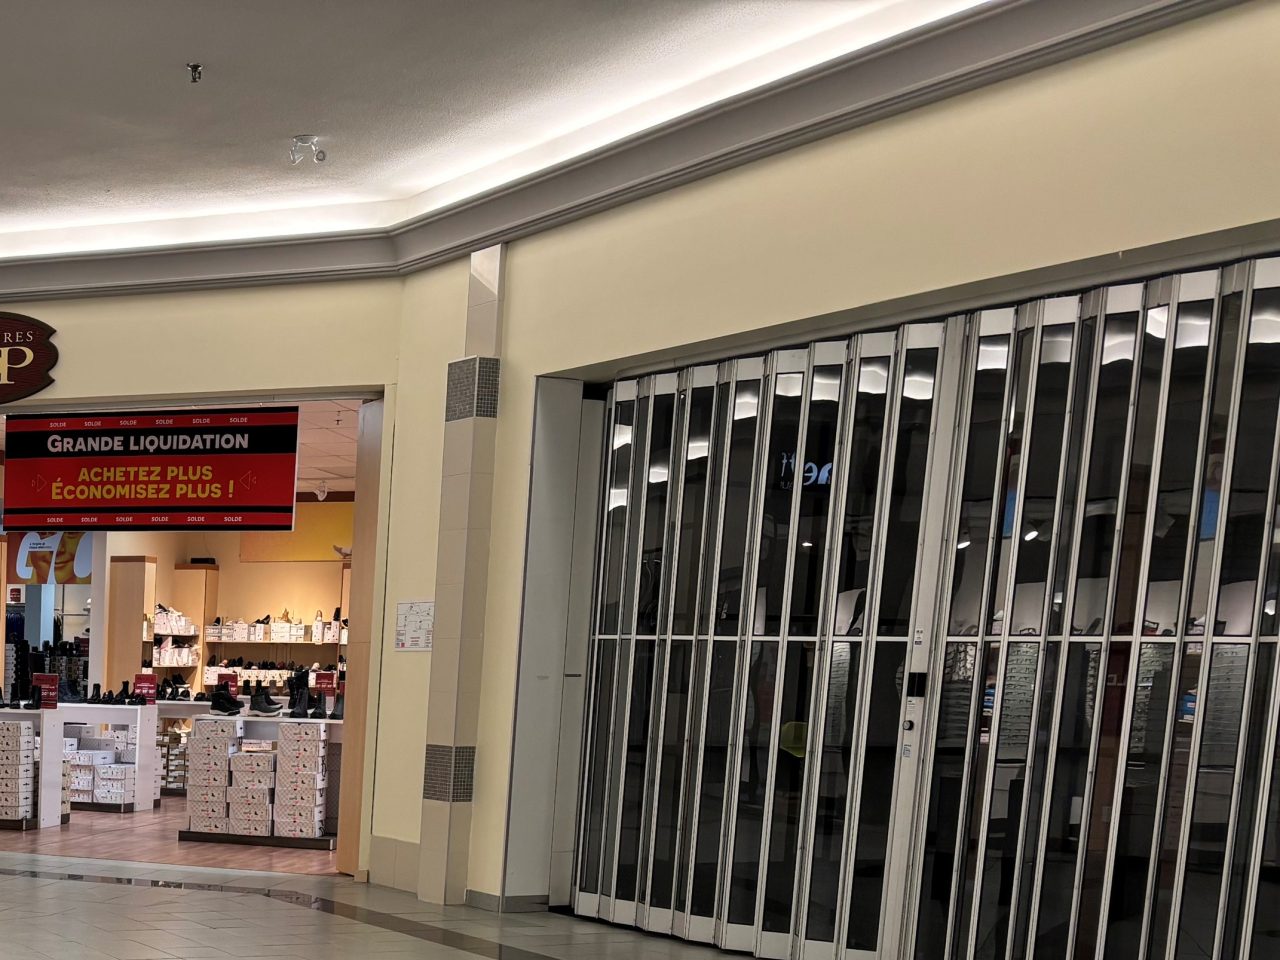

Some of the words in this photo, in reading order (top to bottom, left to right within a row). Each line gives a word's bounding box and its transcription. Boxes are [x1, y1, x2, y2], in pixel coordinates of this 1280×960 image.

[47, 434, 124, 453] GRANDE
[129, 433, 249, 452] LIQUIDATION
[78, 466, 161, 481] ACHETEZ
[166, 465, 213, 480] PLUS
[51, 477, 170, 500] ÉCONOMISEZ
[175, 483, 222, 498] PLUS
